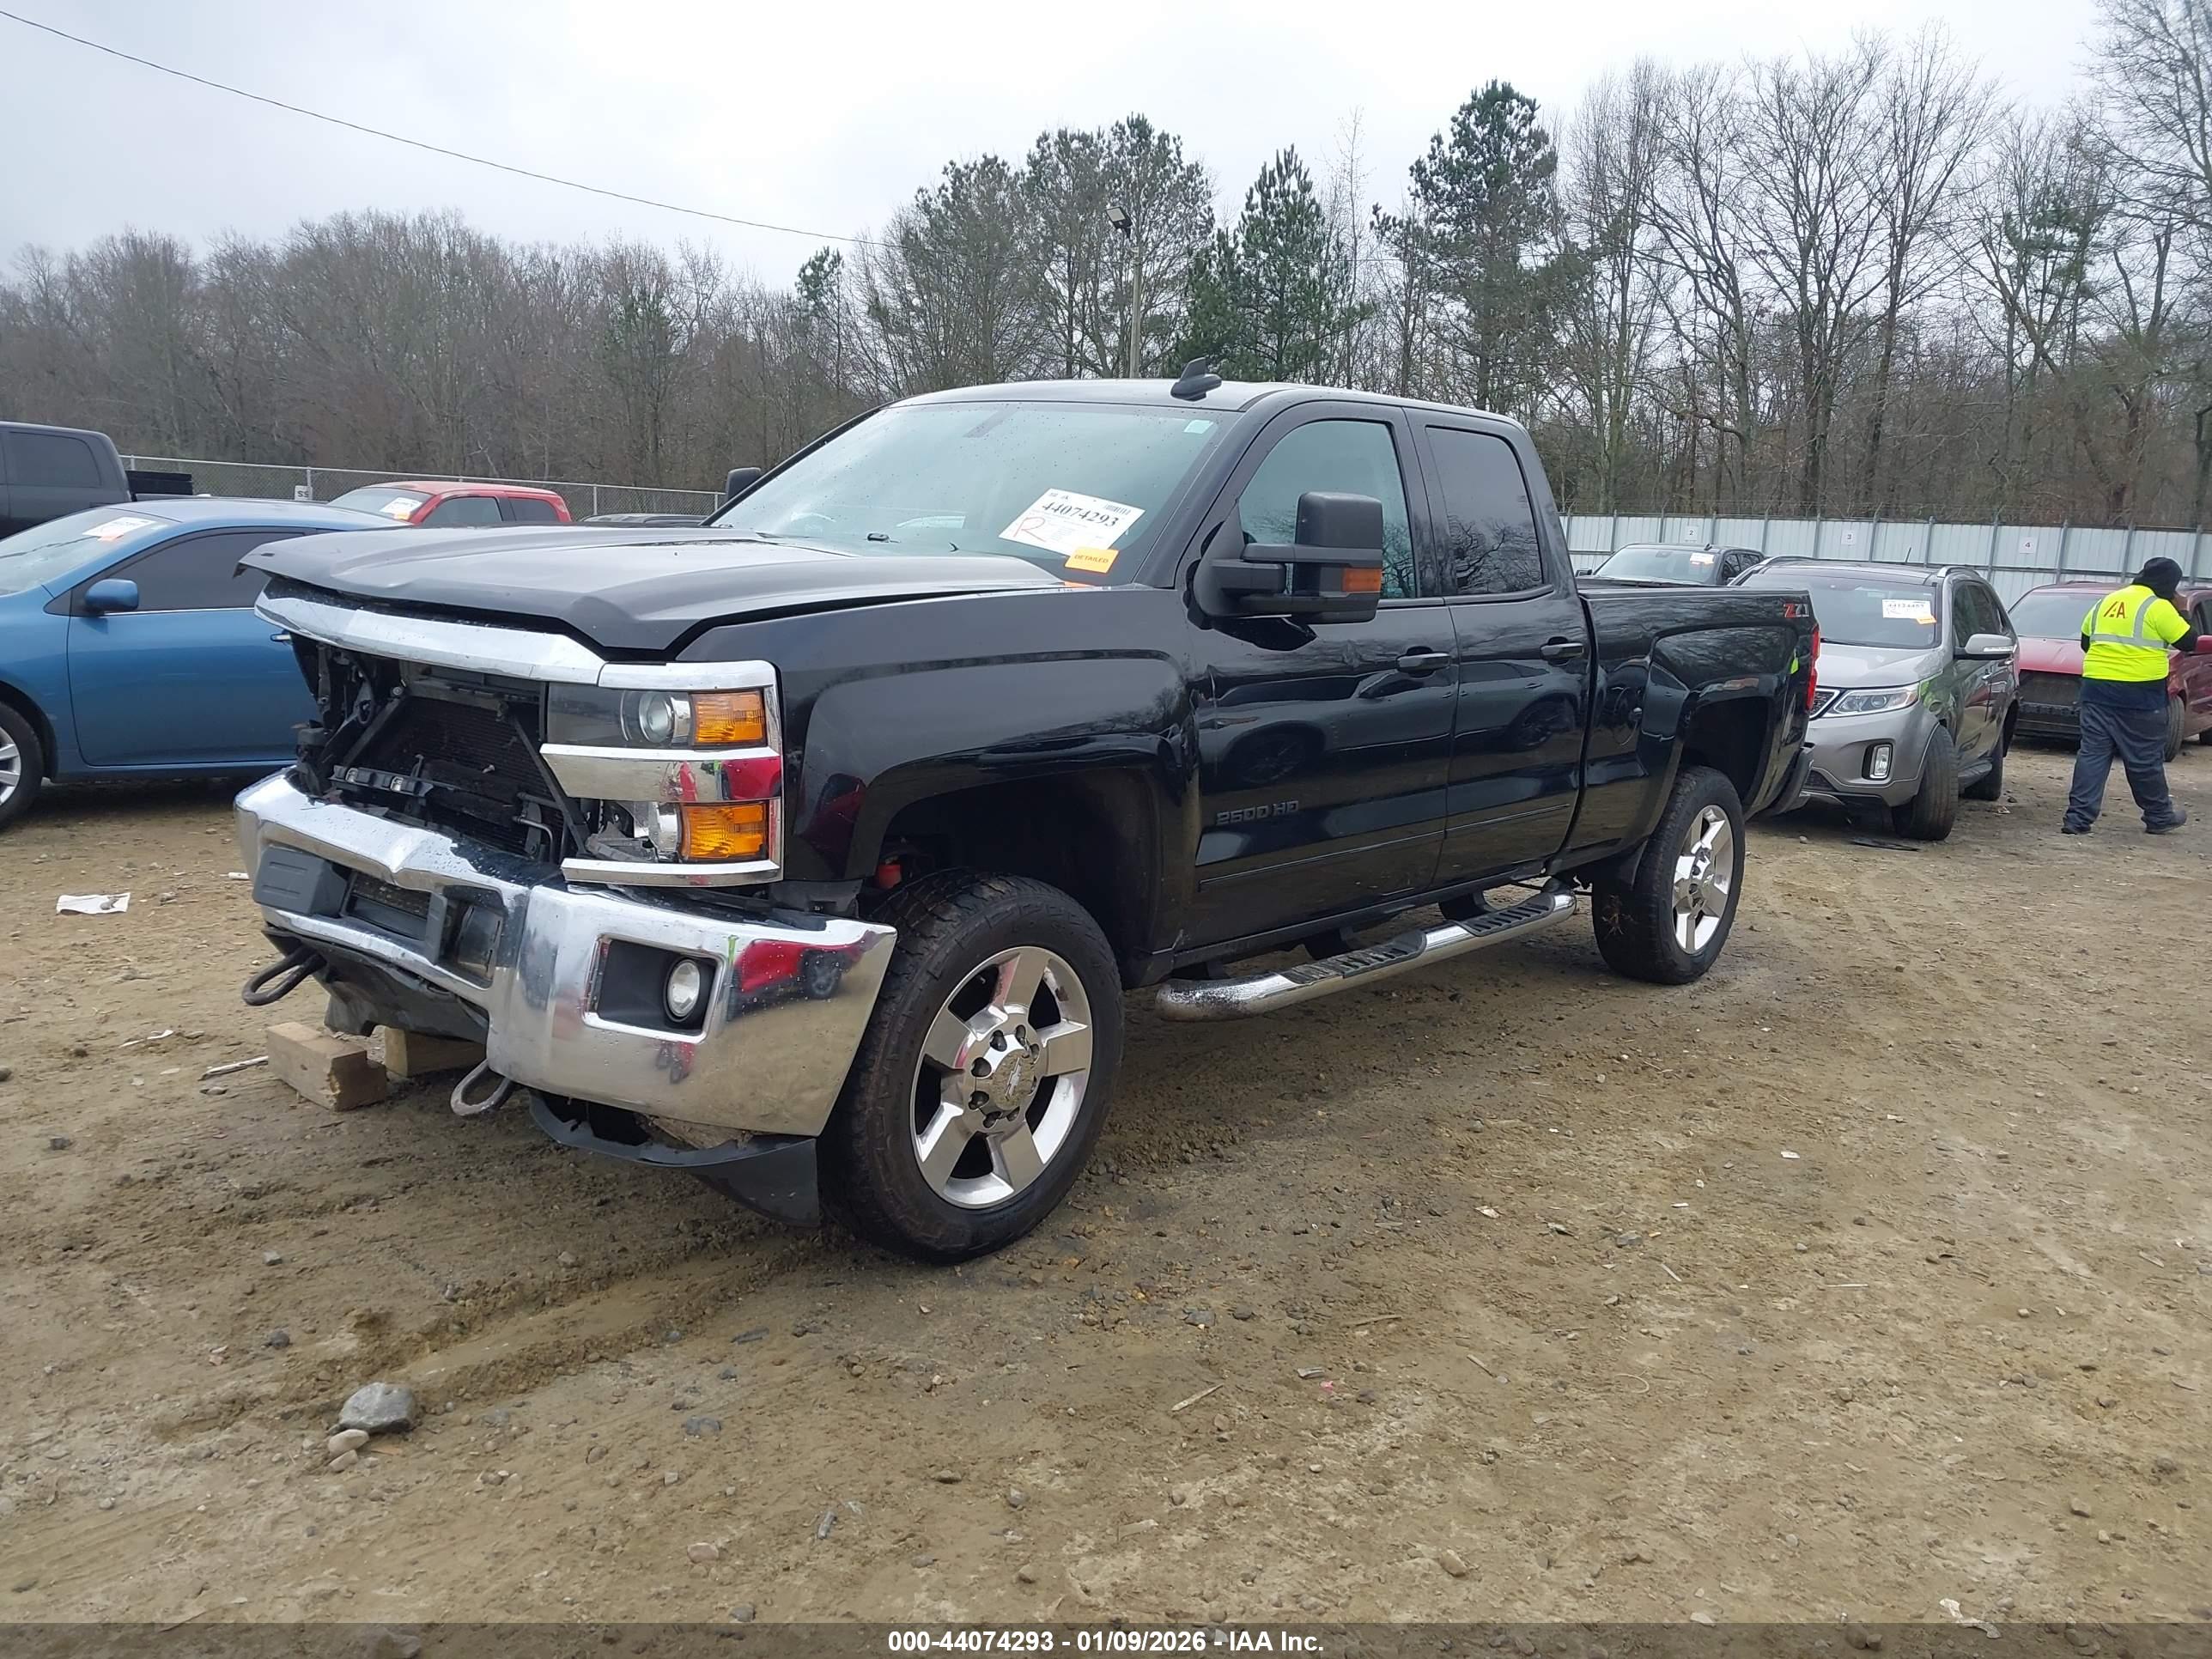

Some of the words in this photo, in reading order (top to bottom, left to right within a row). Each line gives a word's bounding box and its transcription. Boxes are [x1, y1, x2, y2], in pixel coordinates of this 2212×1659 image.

[1042, 501, 1119, 527] 44074293
[1012, 515, 1048, 543] R
[1073, 554, 1109, 564] DETAILED
[1216, 805, 1269, 825] 2500
[1273, 799, 1299, 817] HD
